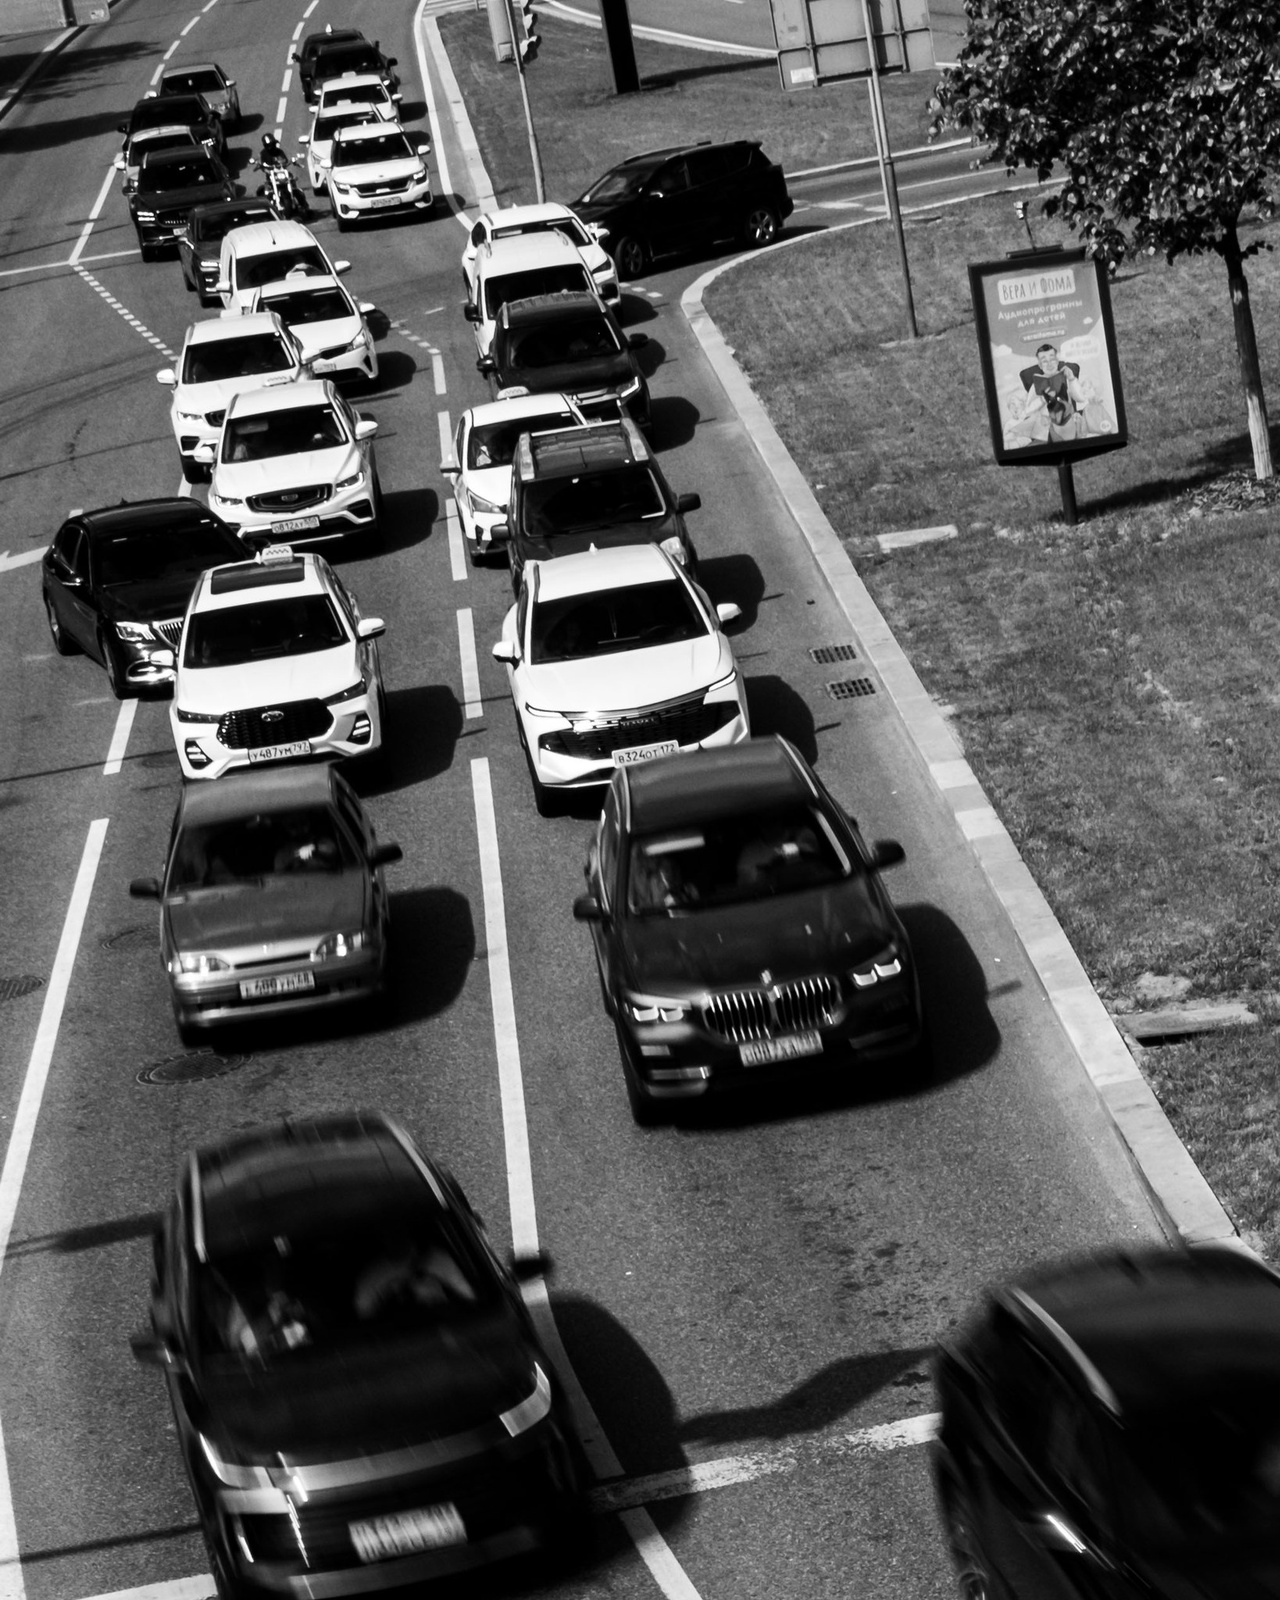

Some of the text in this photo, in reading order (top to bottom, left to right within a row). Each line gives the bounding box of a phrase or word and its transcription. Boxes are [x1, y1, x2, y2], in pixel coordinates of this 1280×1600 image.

[997, 300, 1083, 320] Аудиопрограммы
[1017, 311, 1066, 328] для детей
